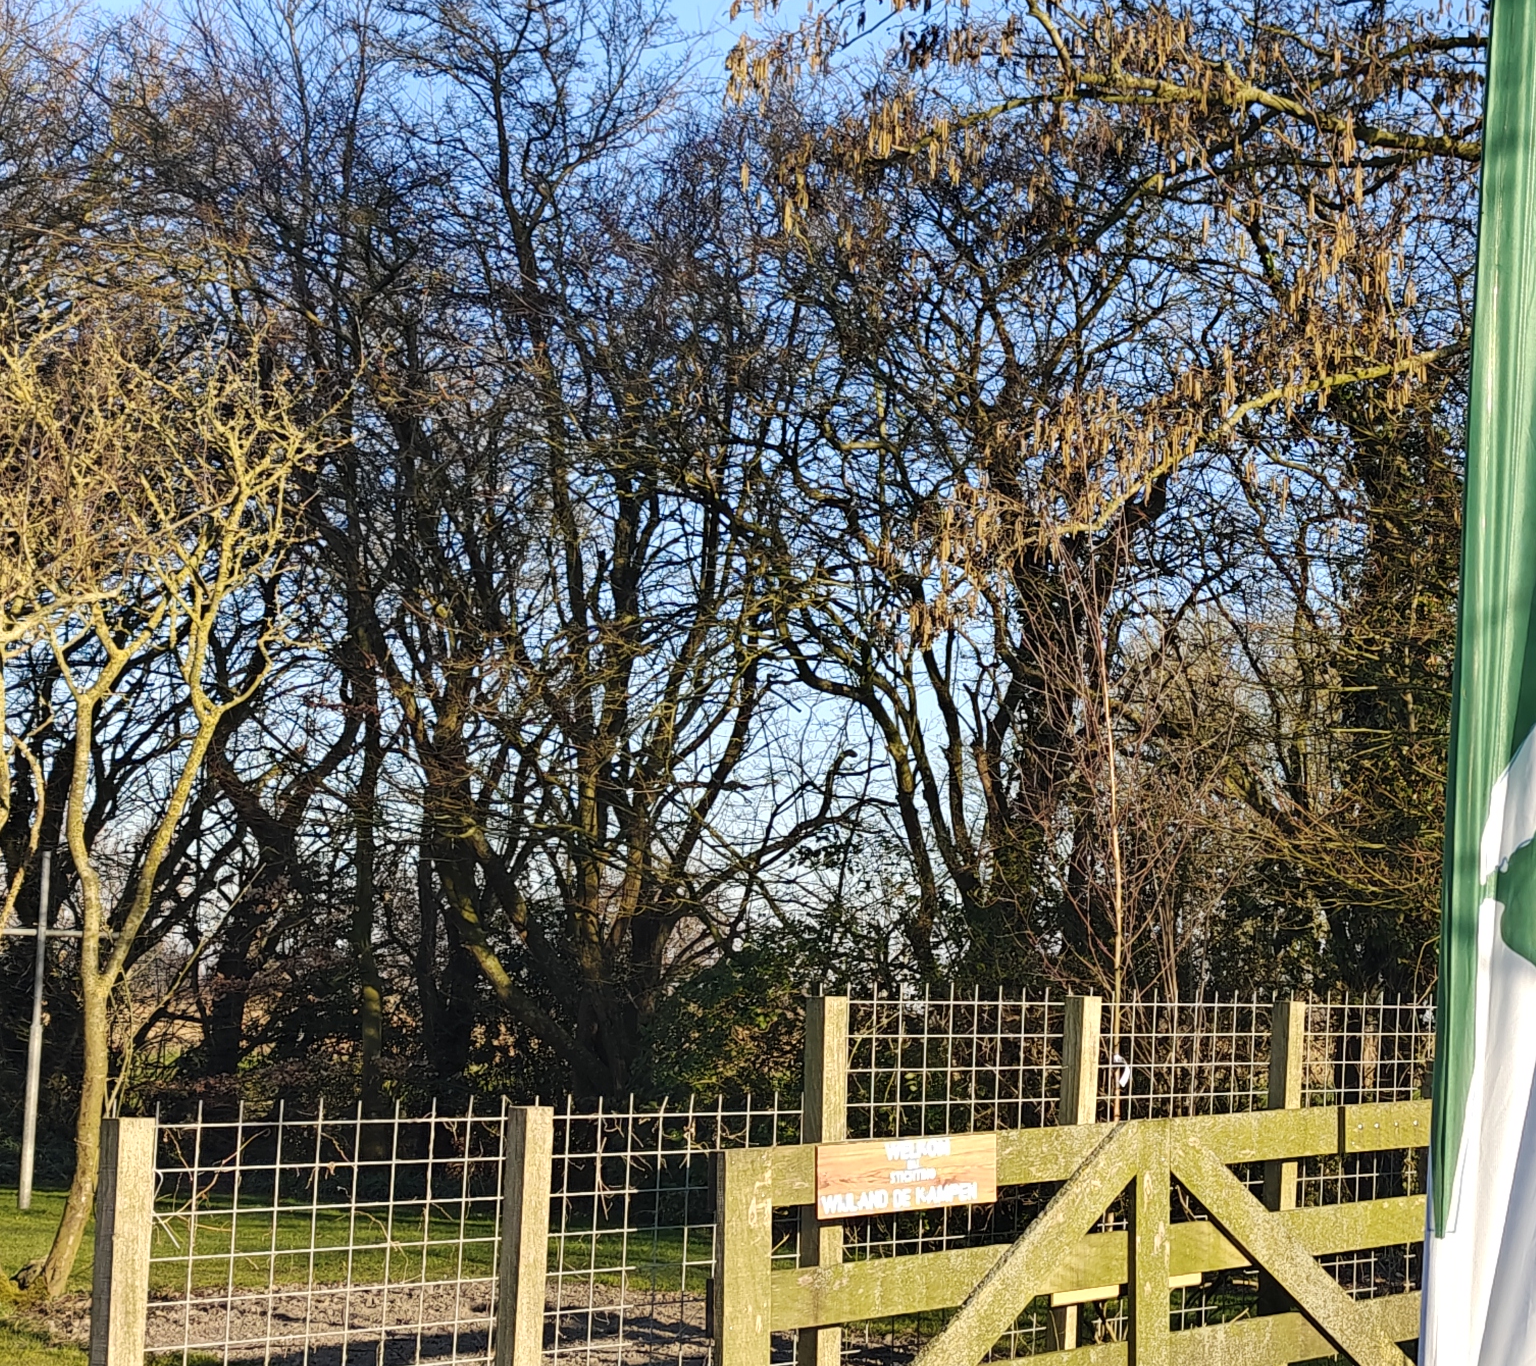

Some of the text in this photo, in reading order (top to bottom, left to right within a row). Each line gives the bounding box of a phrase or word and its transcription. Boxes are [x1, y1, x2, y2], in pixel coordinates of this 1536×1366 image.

[883, 1136, 951, 1162] WELKOM
[892, 1188, 912, 1209] DE
[915, 1181, 978, 1206] KAMPEN
